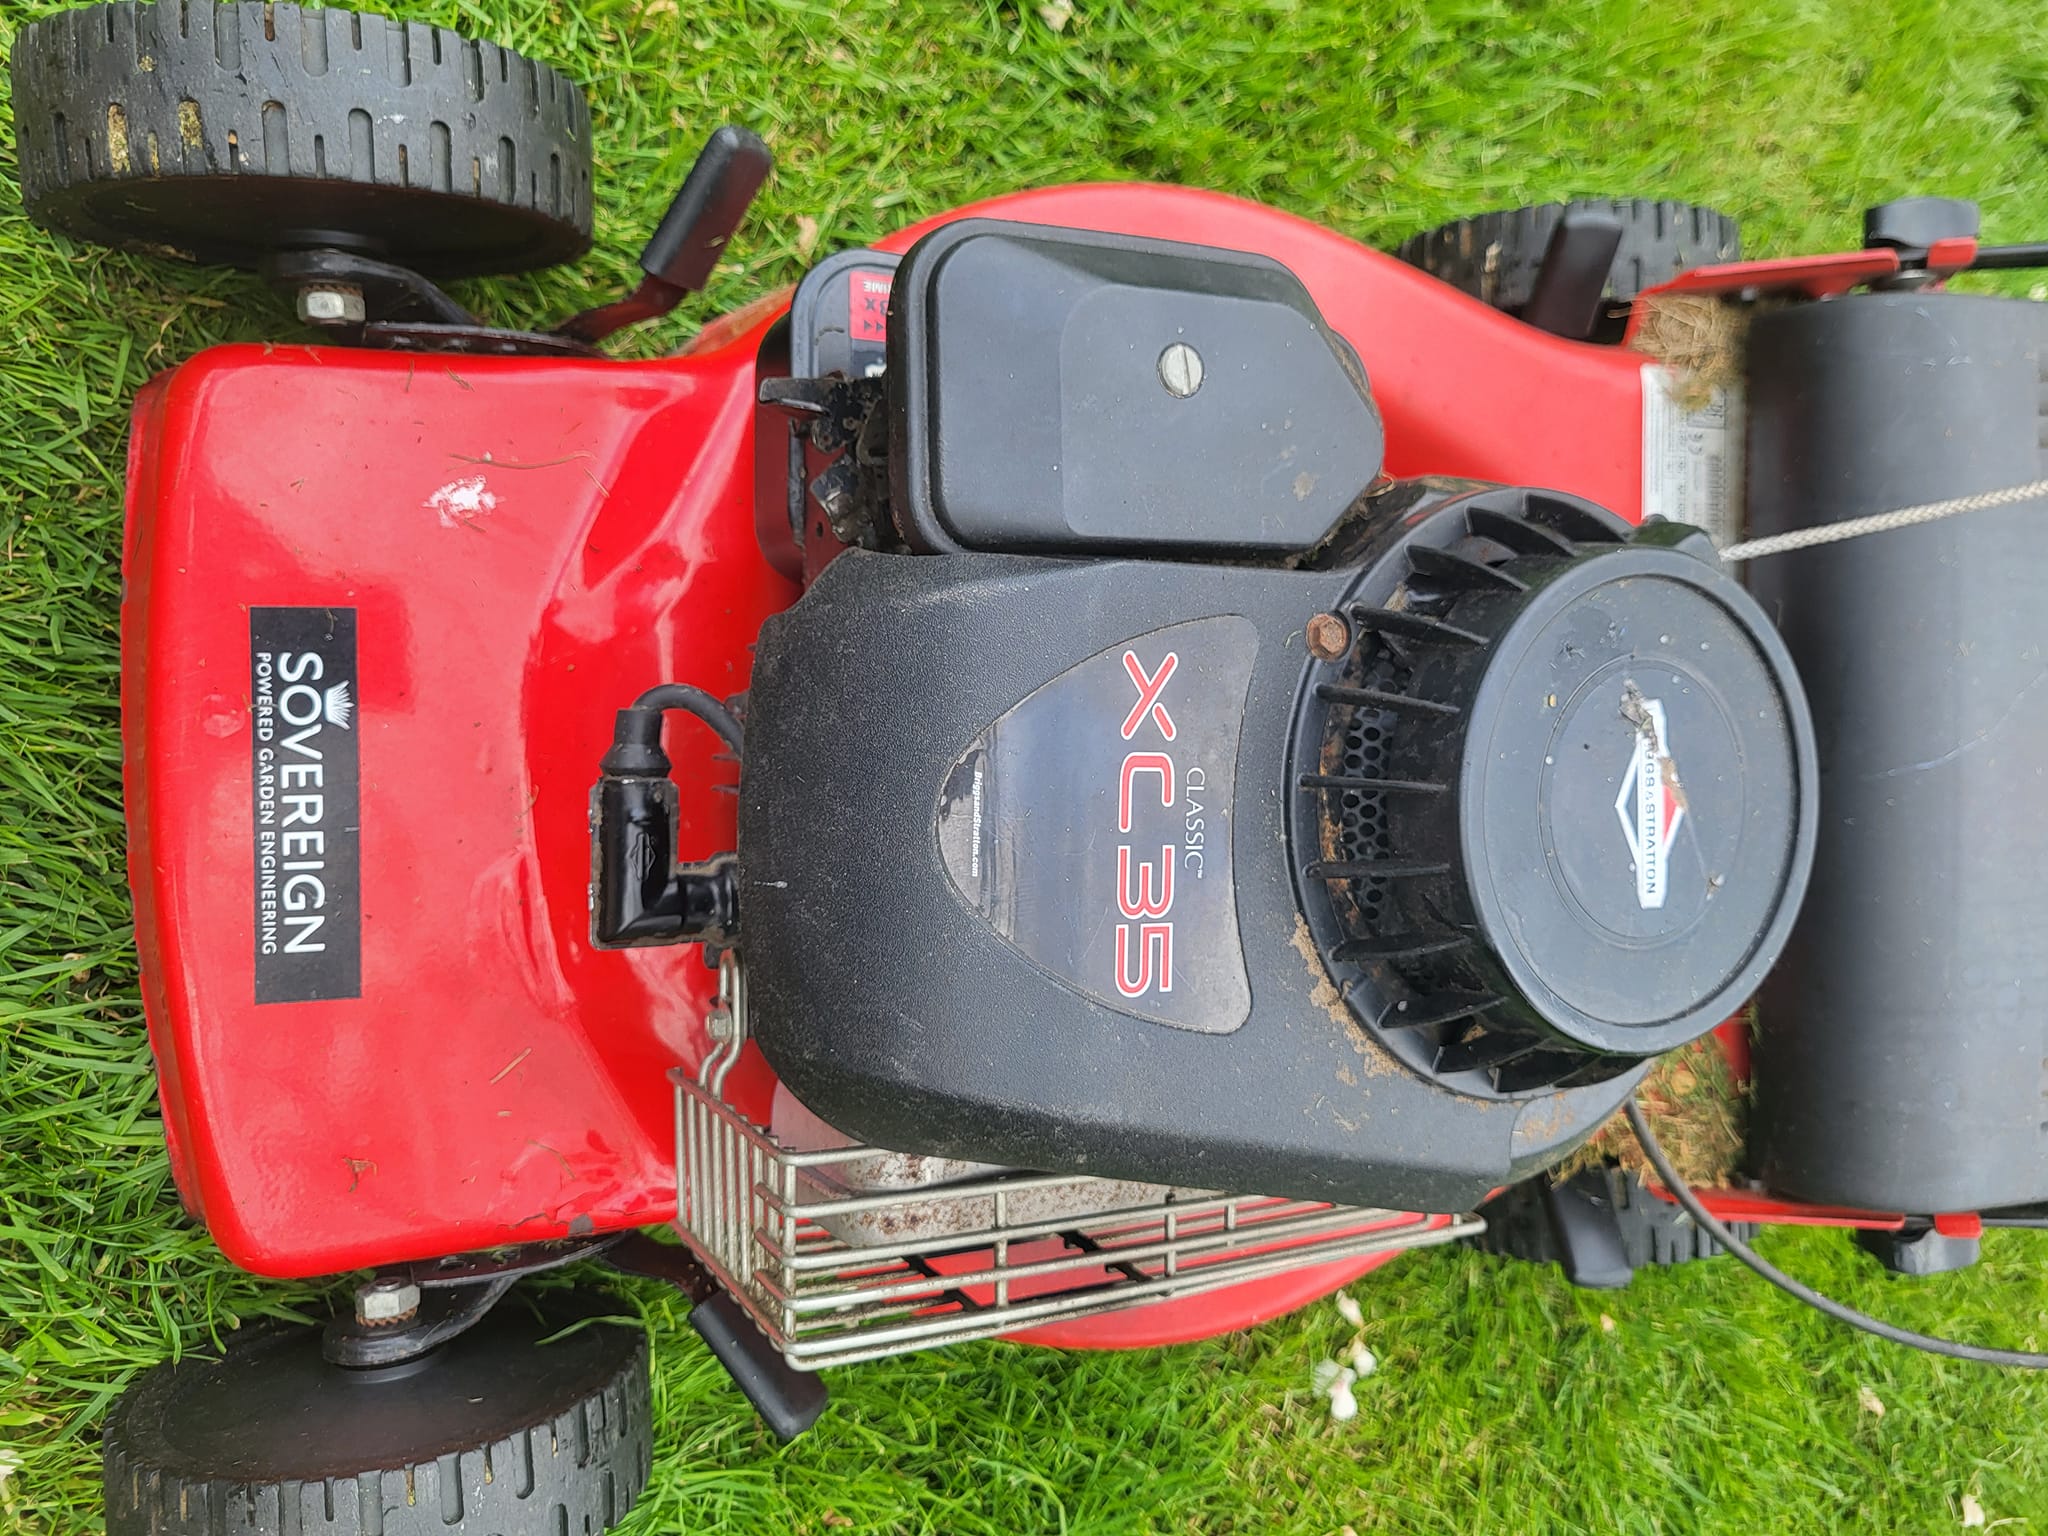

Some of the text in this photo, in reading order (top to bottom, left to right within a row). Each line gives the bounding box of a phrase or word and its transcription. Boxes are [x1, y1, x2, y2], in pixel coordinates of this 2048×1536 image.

[255, 651, 278, 955] POWERED GARDEN ENGINEERING
[277, 651, 327, 954] SOVEREIGN
[971, 771, 983, 878] BriggsandStratton.com
